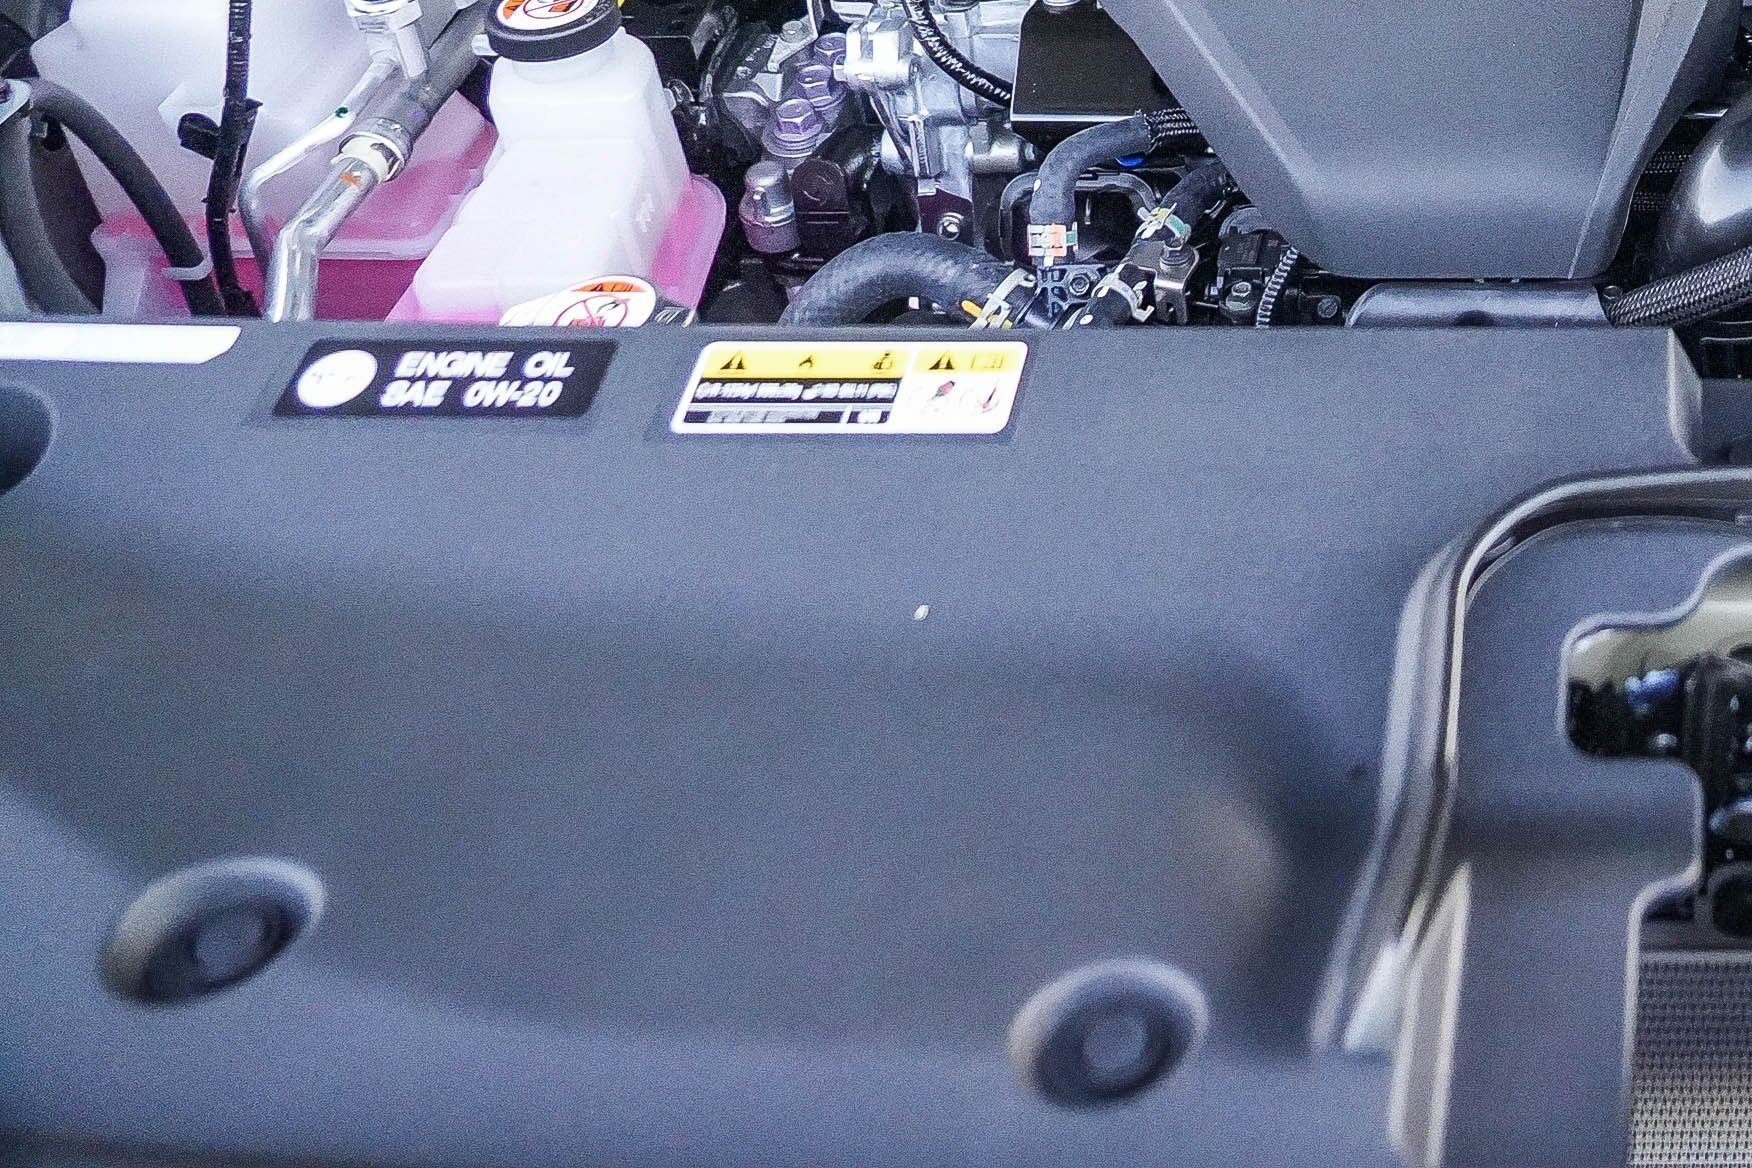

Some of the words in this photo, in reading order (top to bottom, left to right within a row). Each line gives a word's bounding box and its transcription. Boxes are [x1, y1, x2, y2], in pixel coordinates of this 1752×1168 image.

[394, 350, 514, 378] ENGINE
[523, 350, 575, 378] OIL
[380, 380, 451, 408] SAE
[463, 380, 564, 408] 0W-20
